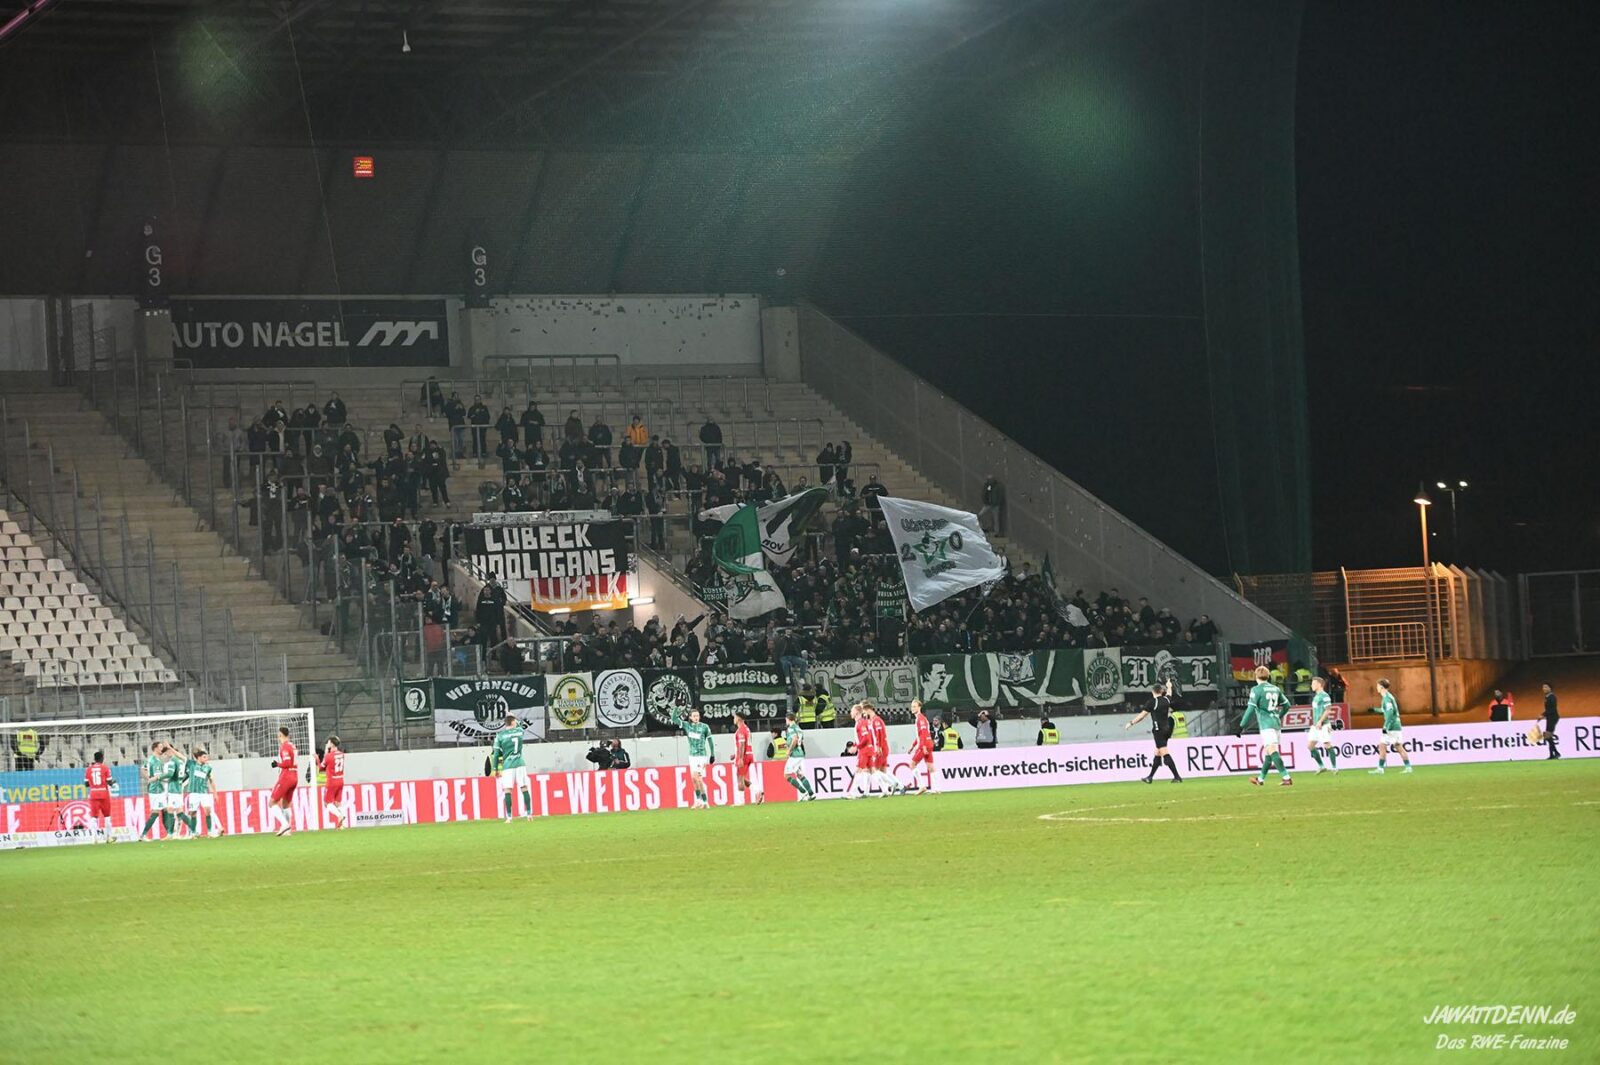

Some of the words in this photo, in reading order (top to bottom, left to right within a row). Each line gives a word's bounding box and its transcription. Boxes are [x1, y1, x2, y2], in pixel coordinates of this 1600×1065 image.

[149, 267, 161, 286] 3
[474, 268, 486, 286] 3
[171, 321, 244, 348] AUTO
[252, 321, 349, 347] NAGEL
[471, 549, 616, 580] HOOLIGANS
[475, 681, 537, 698] FANCLUB
[703, 669, 779, 690] Frontside
[434, 778, 480, 822] BEI
